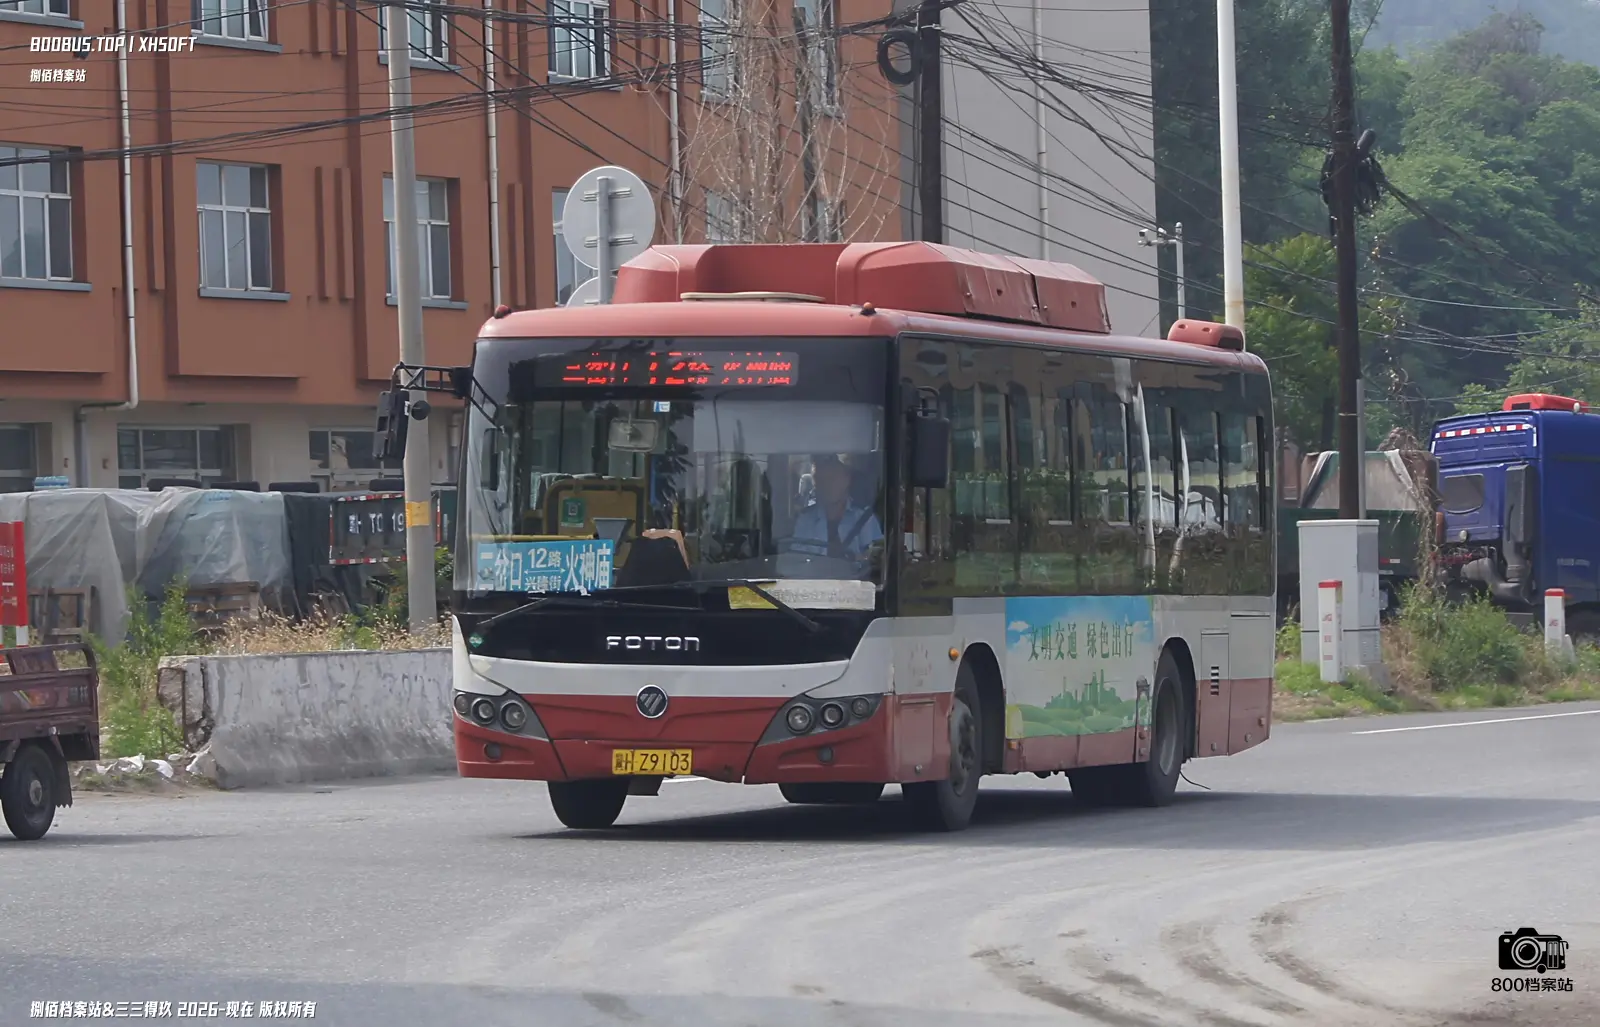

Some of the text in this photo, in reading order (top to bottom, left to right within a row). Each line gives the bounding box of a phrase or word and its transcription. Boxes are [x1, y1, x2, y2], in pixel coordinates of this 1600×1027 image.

[528, 547, 562, 569] 12路
[564, 543, 611, 591] 火神庙
[606, 635, 700, 651] FOTON
[1027, 621, 1134, 661] 文明交通 绿色出行
